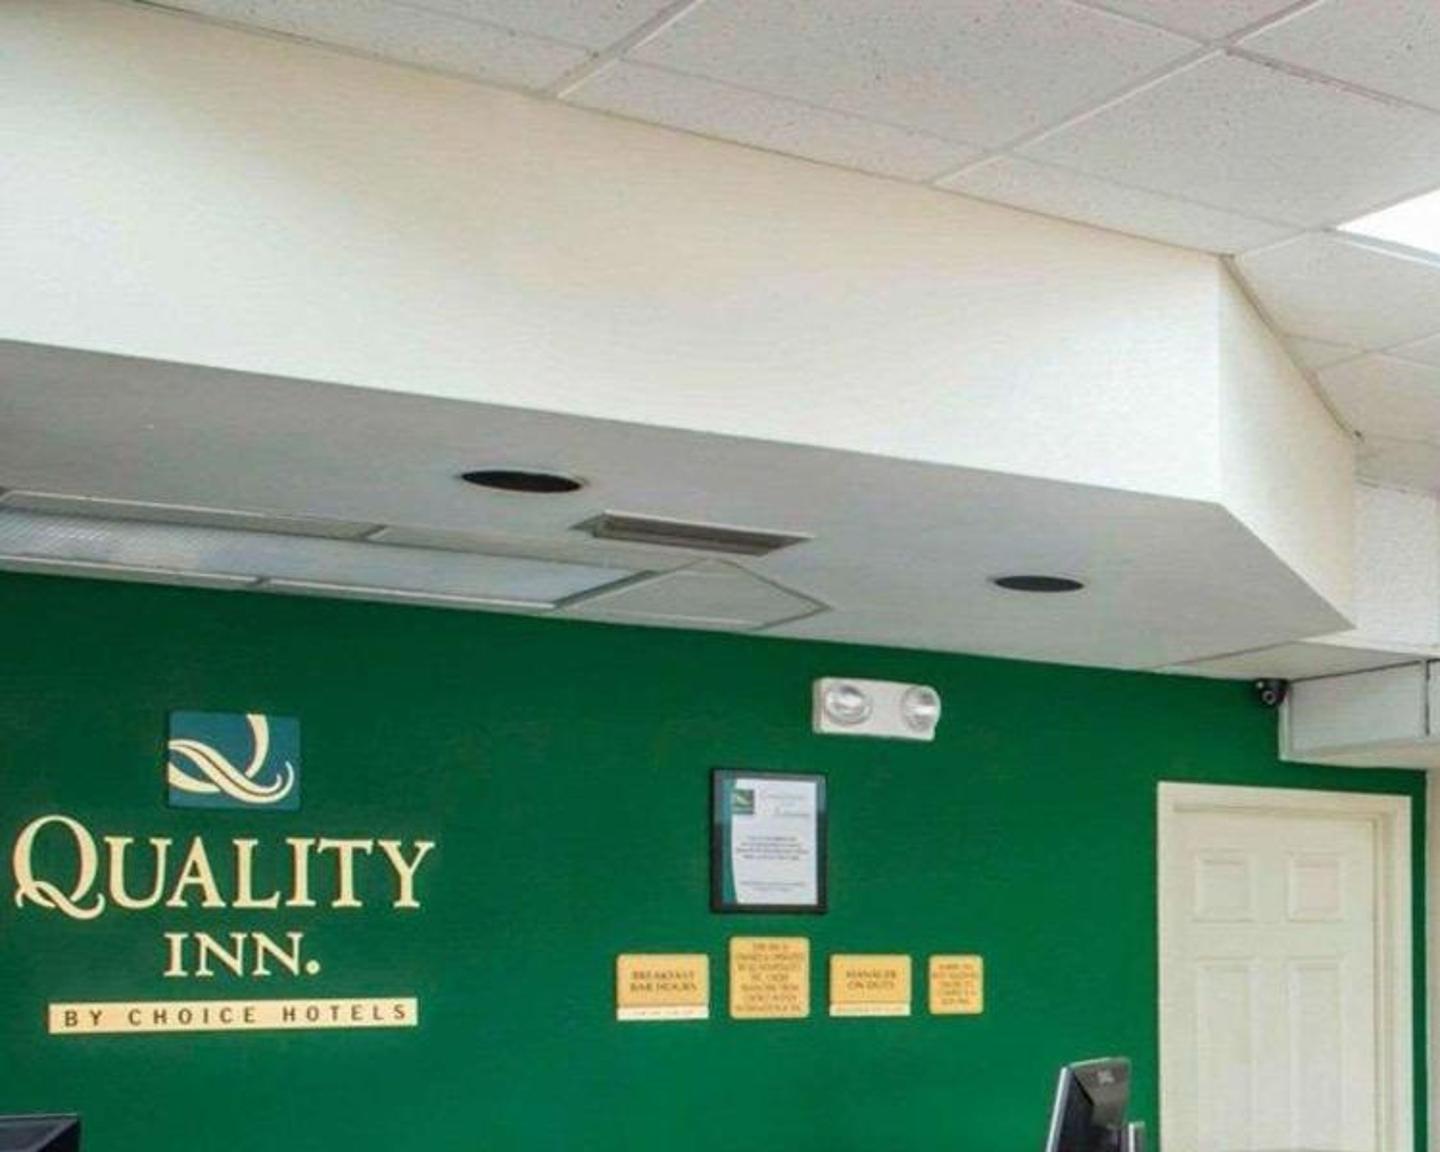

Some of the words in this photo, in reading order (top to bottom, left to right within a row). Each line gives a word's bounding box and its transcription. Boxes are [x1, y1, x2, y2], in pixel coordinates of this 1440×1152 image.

[13, 815, 435, 919] QUALITY
[64, 1010, 104, 1027] BY
[128, 1007, 256, 1026] CHOICE
[282, 1004, 406, 1022] HOTELS
